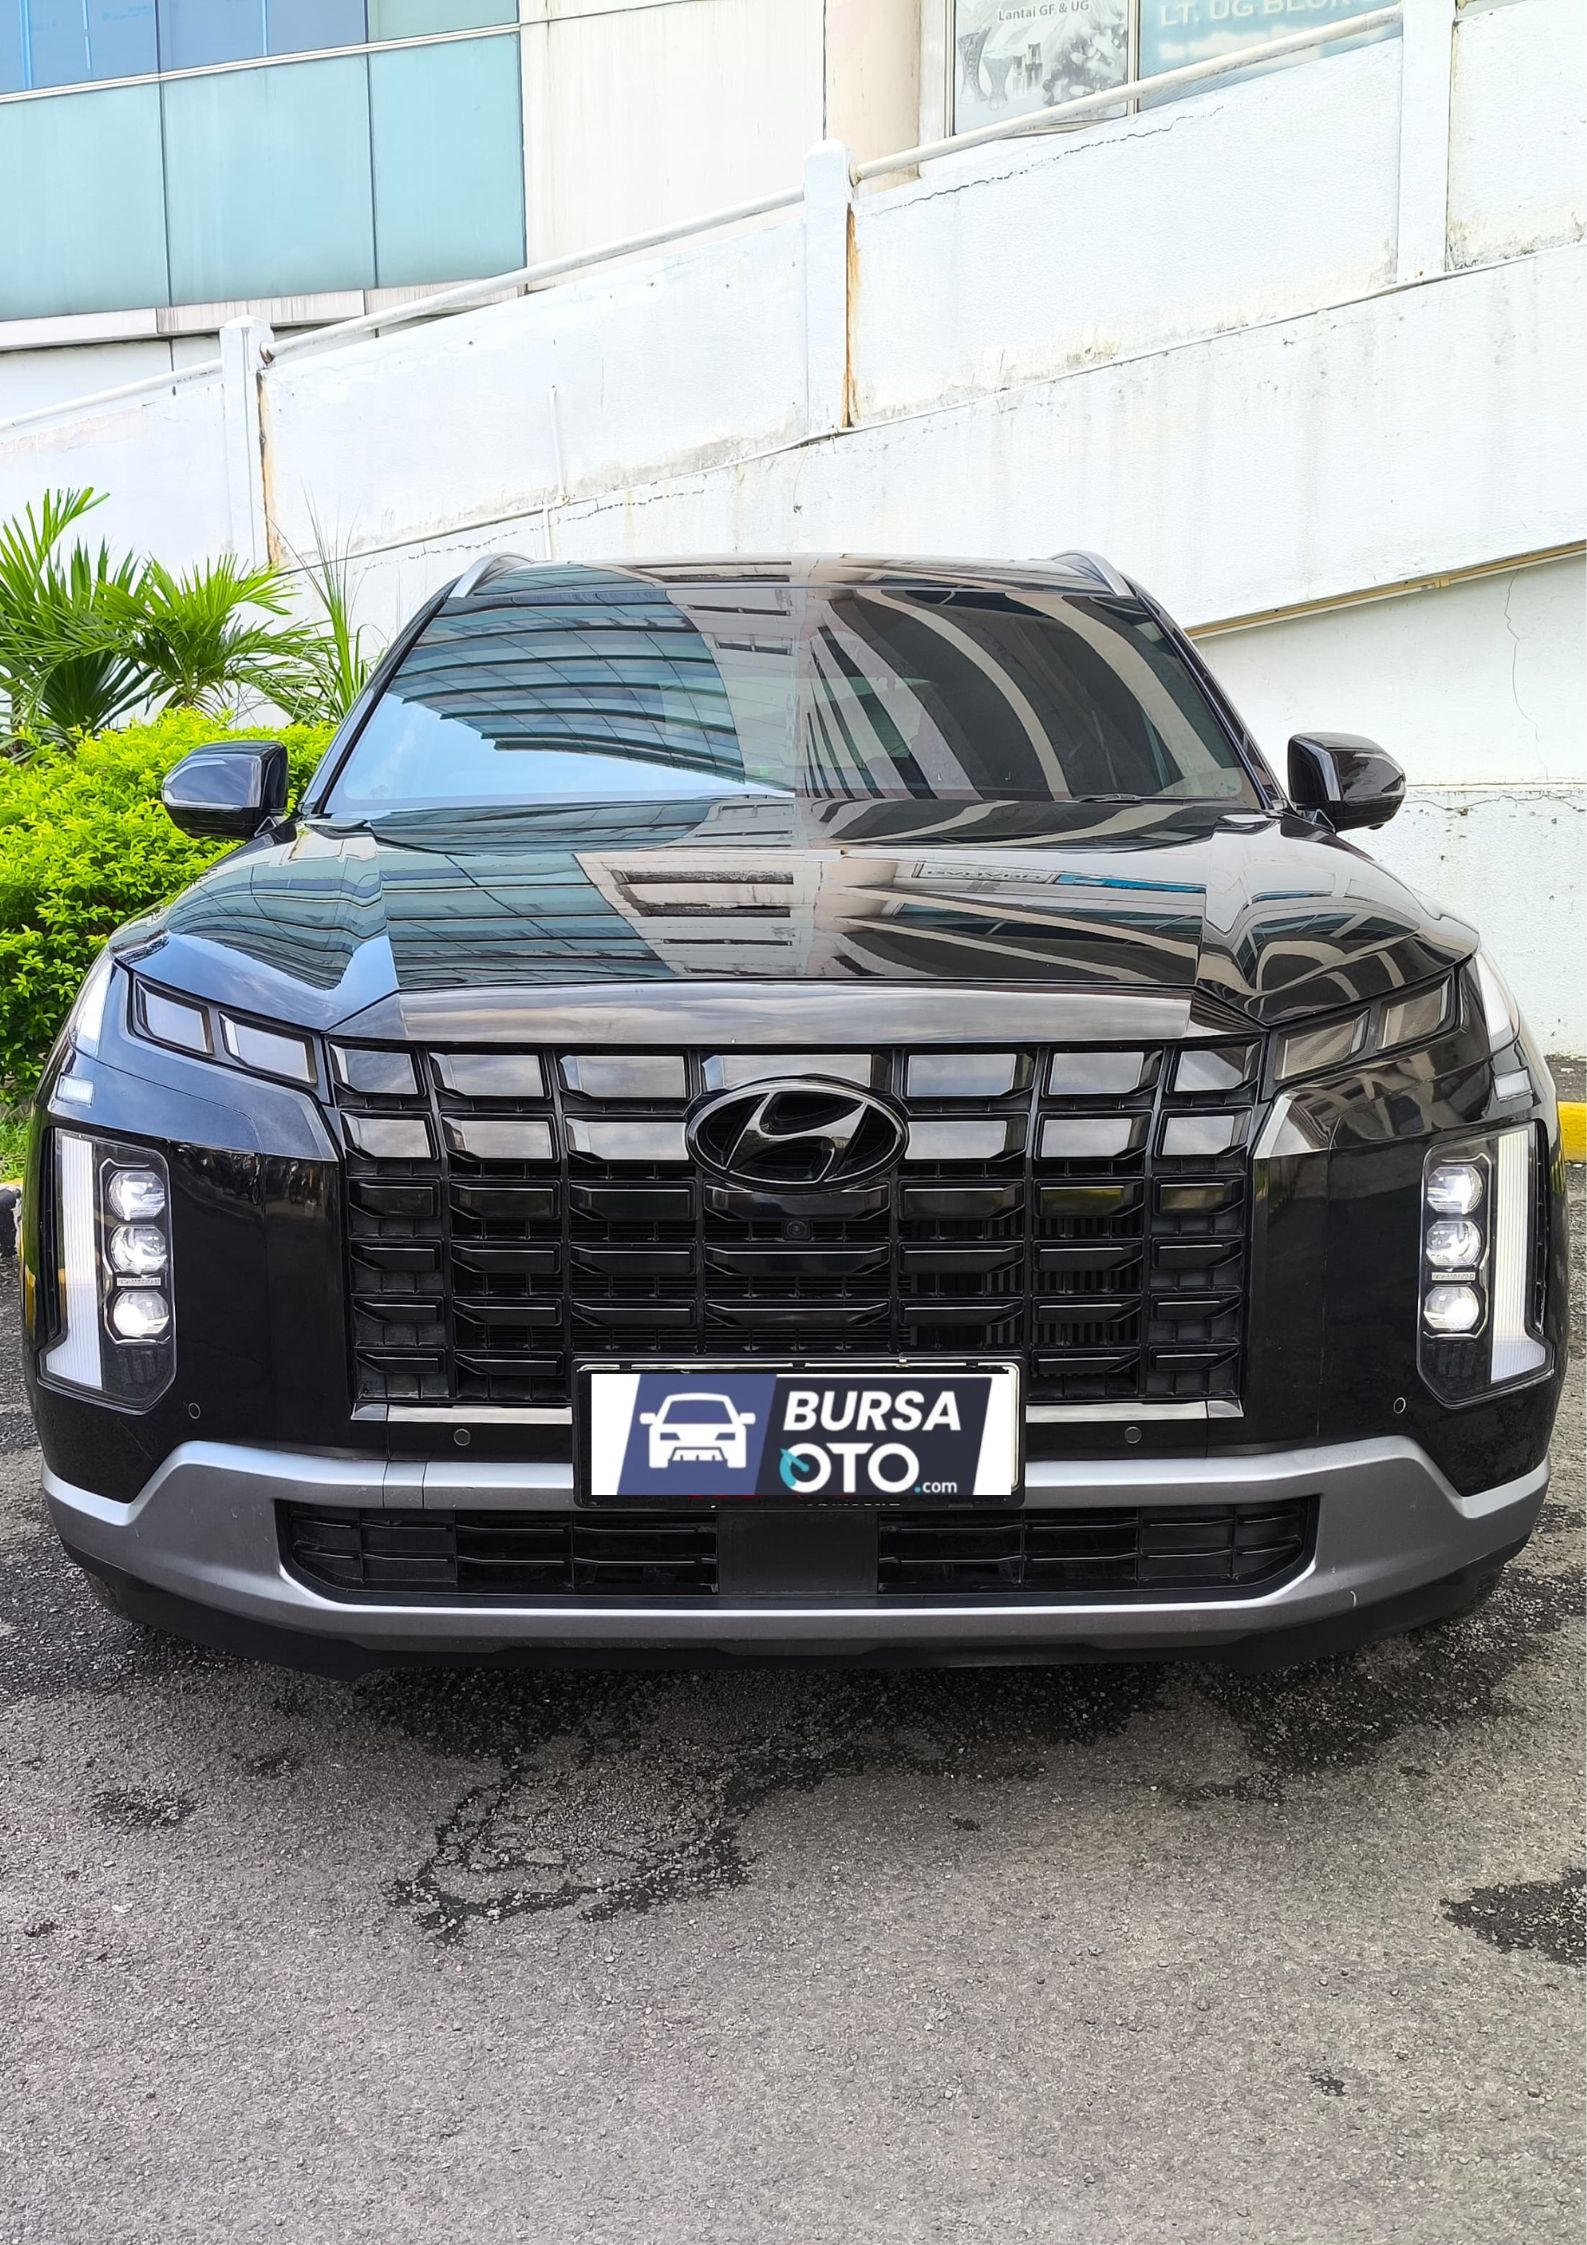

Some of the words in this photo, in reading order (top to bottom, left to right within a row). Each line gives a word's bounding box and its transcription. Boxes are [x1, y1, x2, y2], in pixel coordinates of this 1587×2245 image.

[998, 6, 1036, 21] Lantai
[1039, 4, 1055, 16] GF
[1059, 2, 1068, 13] &
[1071, 0, 1089, 12] UG
[1160, 4, 1199, 27] LT.
[1208, 0, 1255, 20] UG
[1263, 0, 1350, 15] BL
